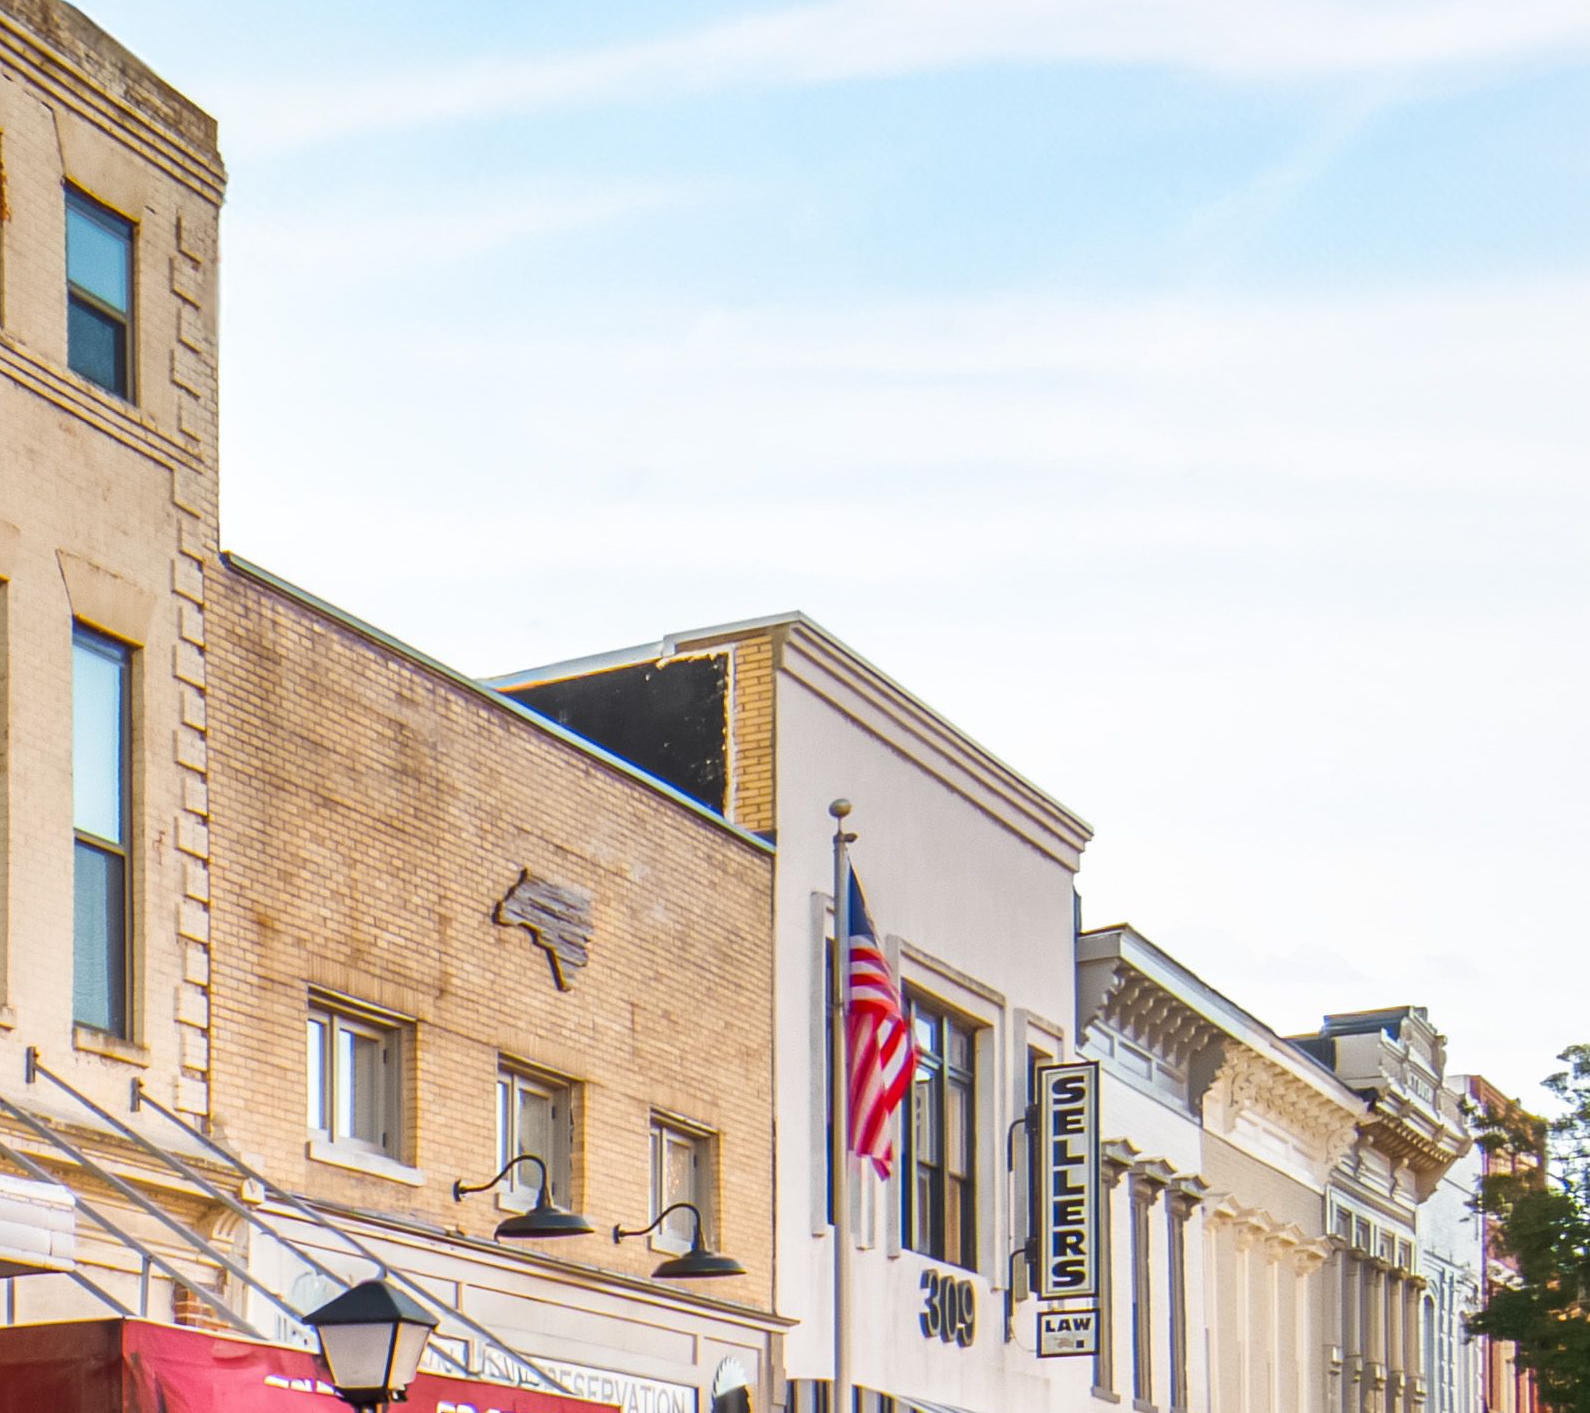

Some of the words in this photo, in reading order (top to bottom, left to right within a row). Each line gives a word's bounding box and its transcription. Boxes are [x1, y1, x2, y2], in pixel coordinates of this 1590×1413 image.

[1051, 1074, 1086, 1288] SELLERS
[919, 1268, 976, 1349] 309
[1044, 1316, 1093, 1333] LAW
